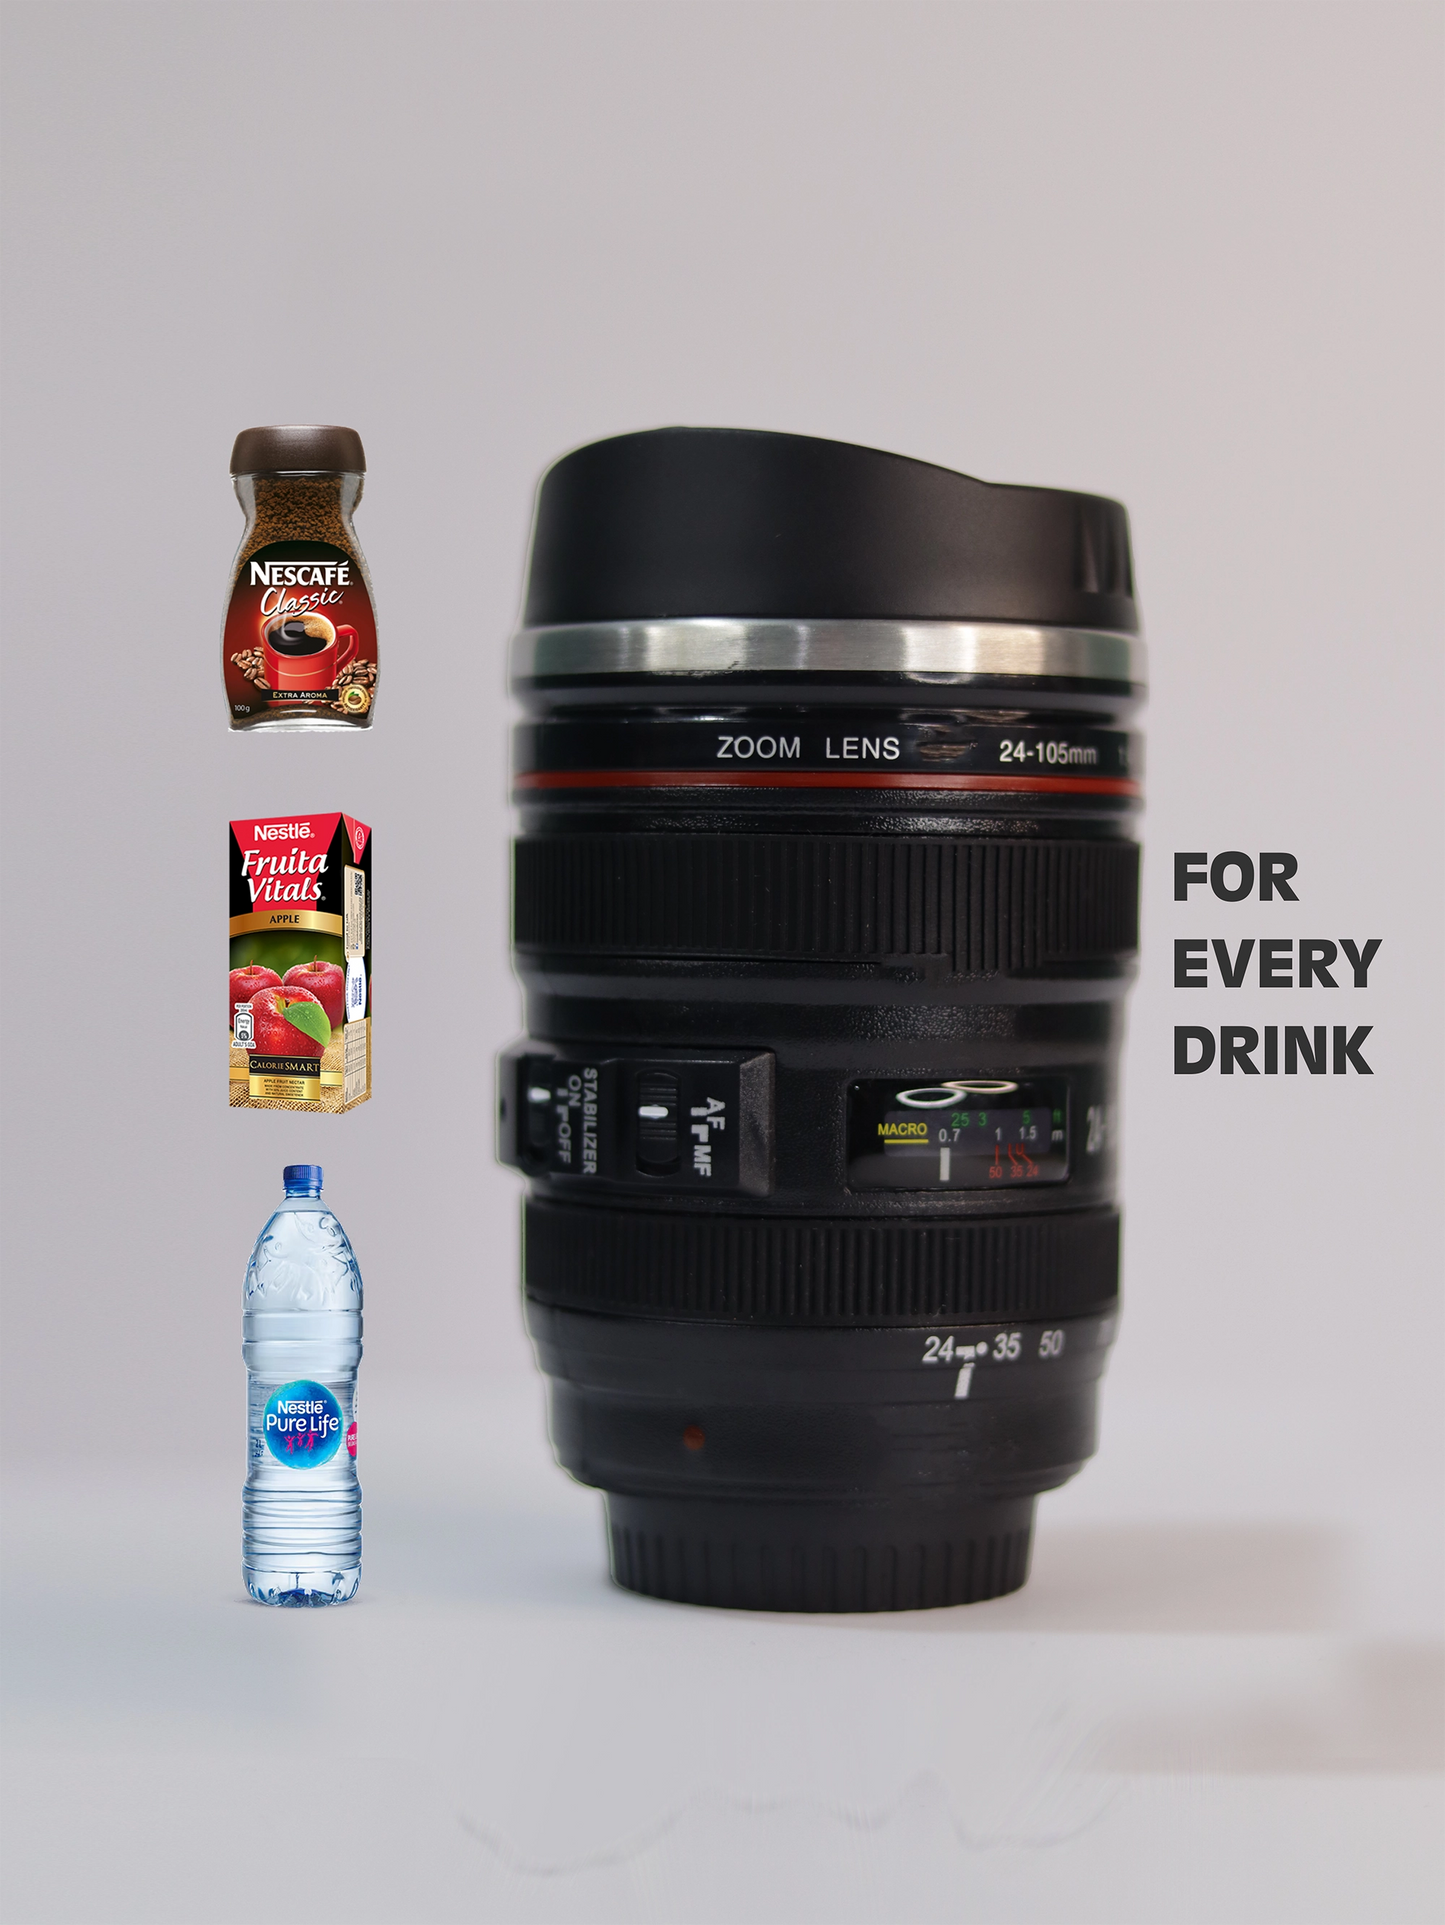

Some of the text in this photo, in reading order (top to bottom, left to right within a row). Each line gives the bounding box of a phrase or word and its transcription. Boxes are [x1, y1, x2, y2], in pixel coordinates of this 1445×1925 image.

[260, 587, 345, 617] Classic
[272, 691, 328, 699] EXTRA AROMA
[717, 736, 800, 759] ZOOM
[826, 736, 900, 760] LENS
[999, 739, 1097, 765] 24-105mm
[241, 847, 329, 877] Fruita
[247, 877, 323, 903] Vitals
[269, 914, 300, 924] APPLE
[568, 1074, 582, 1107] ON
[583, 1067, 598, 1174] STABILIZER
[706, 1096, 726, 1131] AF
[978, 1112, 987, 1127] 3
[877, 1122, 928, 1136] MACRO
[938, 1125, 1064, 1143] 0.7 1 1.5 m
[693, 1144, 712, 1177] MF
[989, 1164, 1039, 1179] 50 35 24
[922, 1335, 955, 1363] 24
[992, 1332, 1022, 1361] 35
[1038, 1329, 1065, 1358] 50
[266, 1413, 339, 1438] Pure Life
